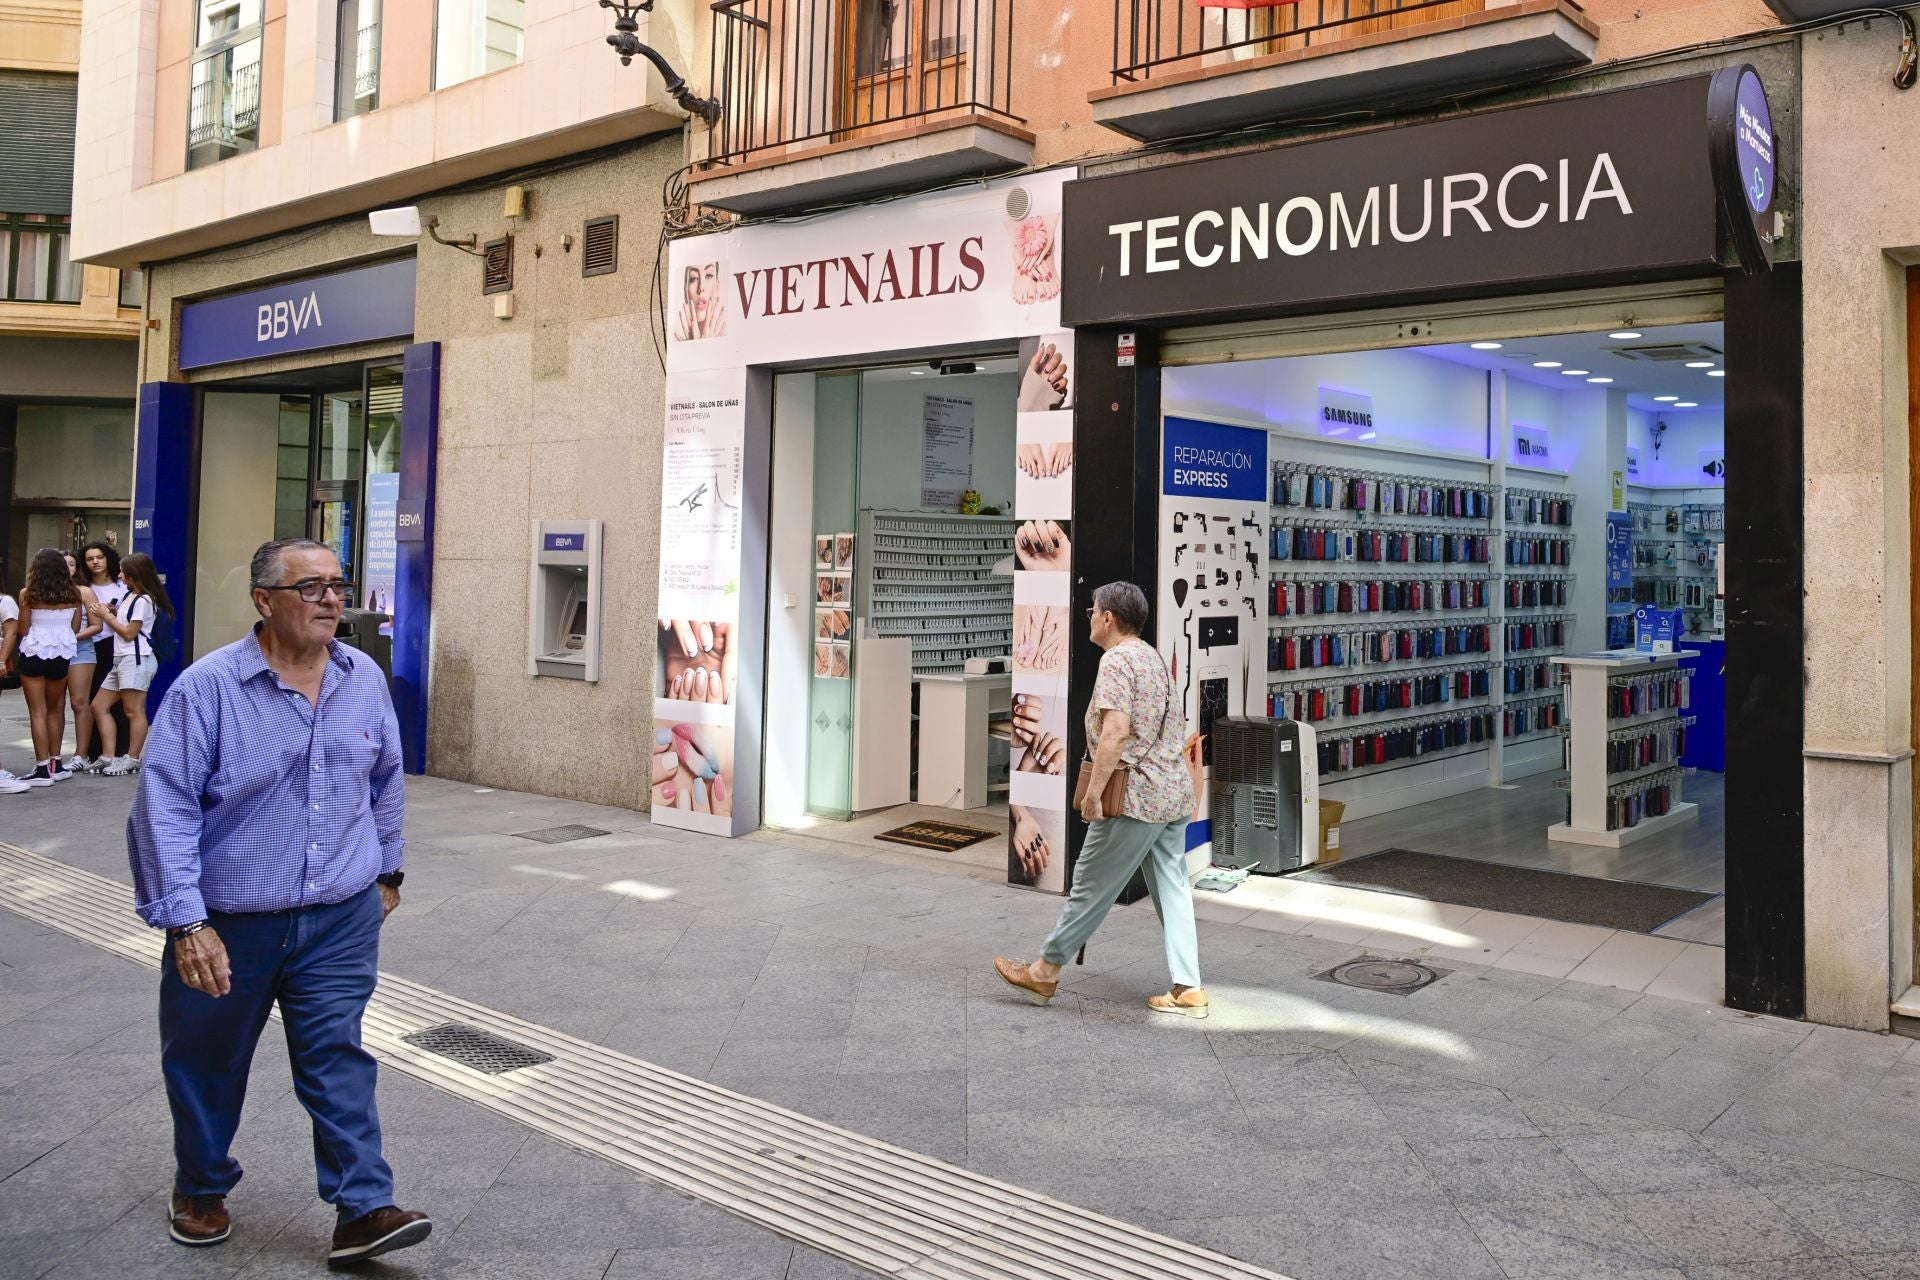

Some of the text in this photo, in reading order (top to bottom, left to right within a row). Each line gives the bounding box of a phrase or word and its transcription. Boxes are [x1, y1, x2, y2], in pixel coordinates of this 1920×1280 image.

[1108, 152, 1634, 277] TECNOMURCIA
[733, 236, 985, 320] VIETNAILS
[257, 290, 322, 342] BBVA
[670, 402, 696, 411] VIETNAILS
[717, 400, 723, 408] DE
[1324, 406, 1373, 427] SAMSUNG
[1174, 446, 1252, 470] REPARACIÓN
[1173, 469, 1228, 488] EXPRESS
[135, 519, 149, 529] BBVA
[399, 513, 421, 527] BBVA
[555, 537, 573, 547] BBVA
